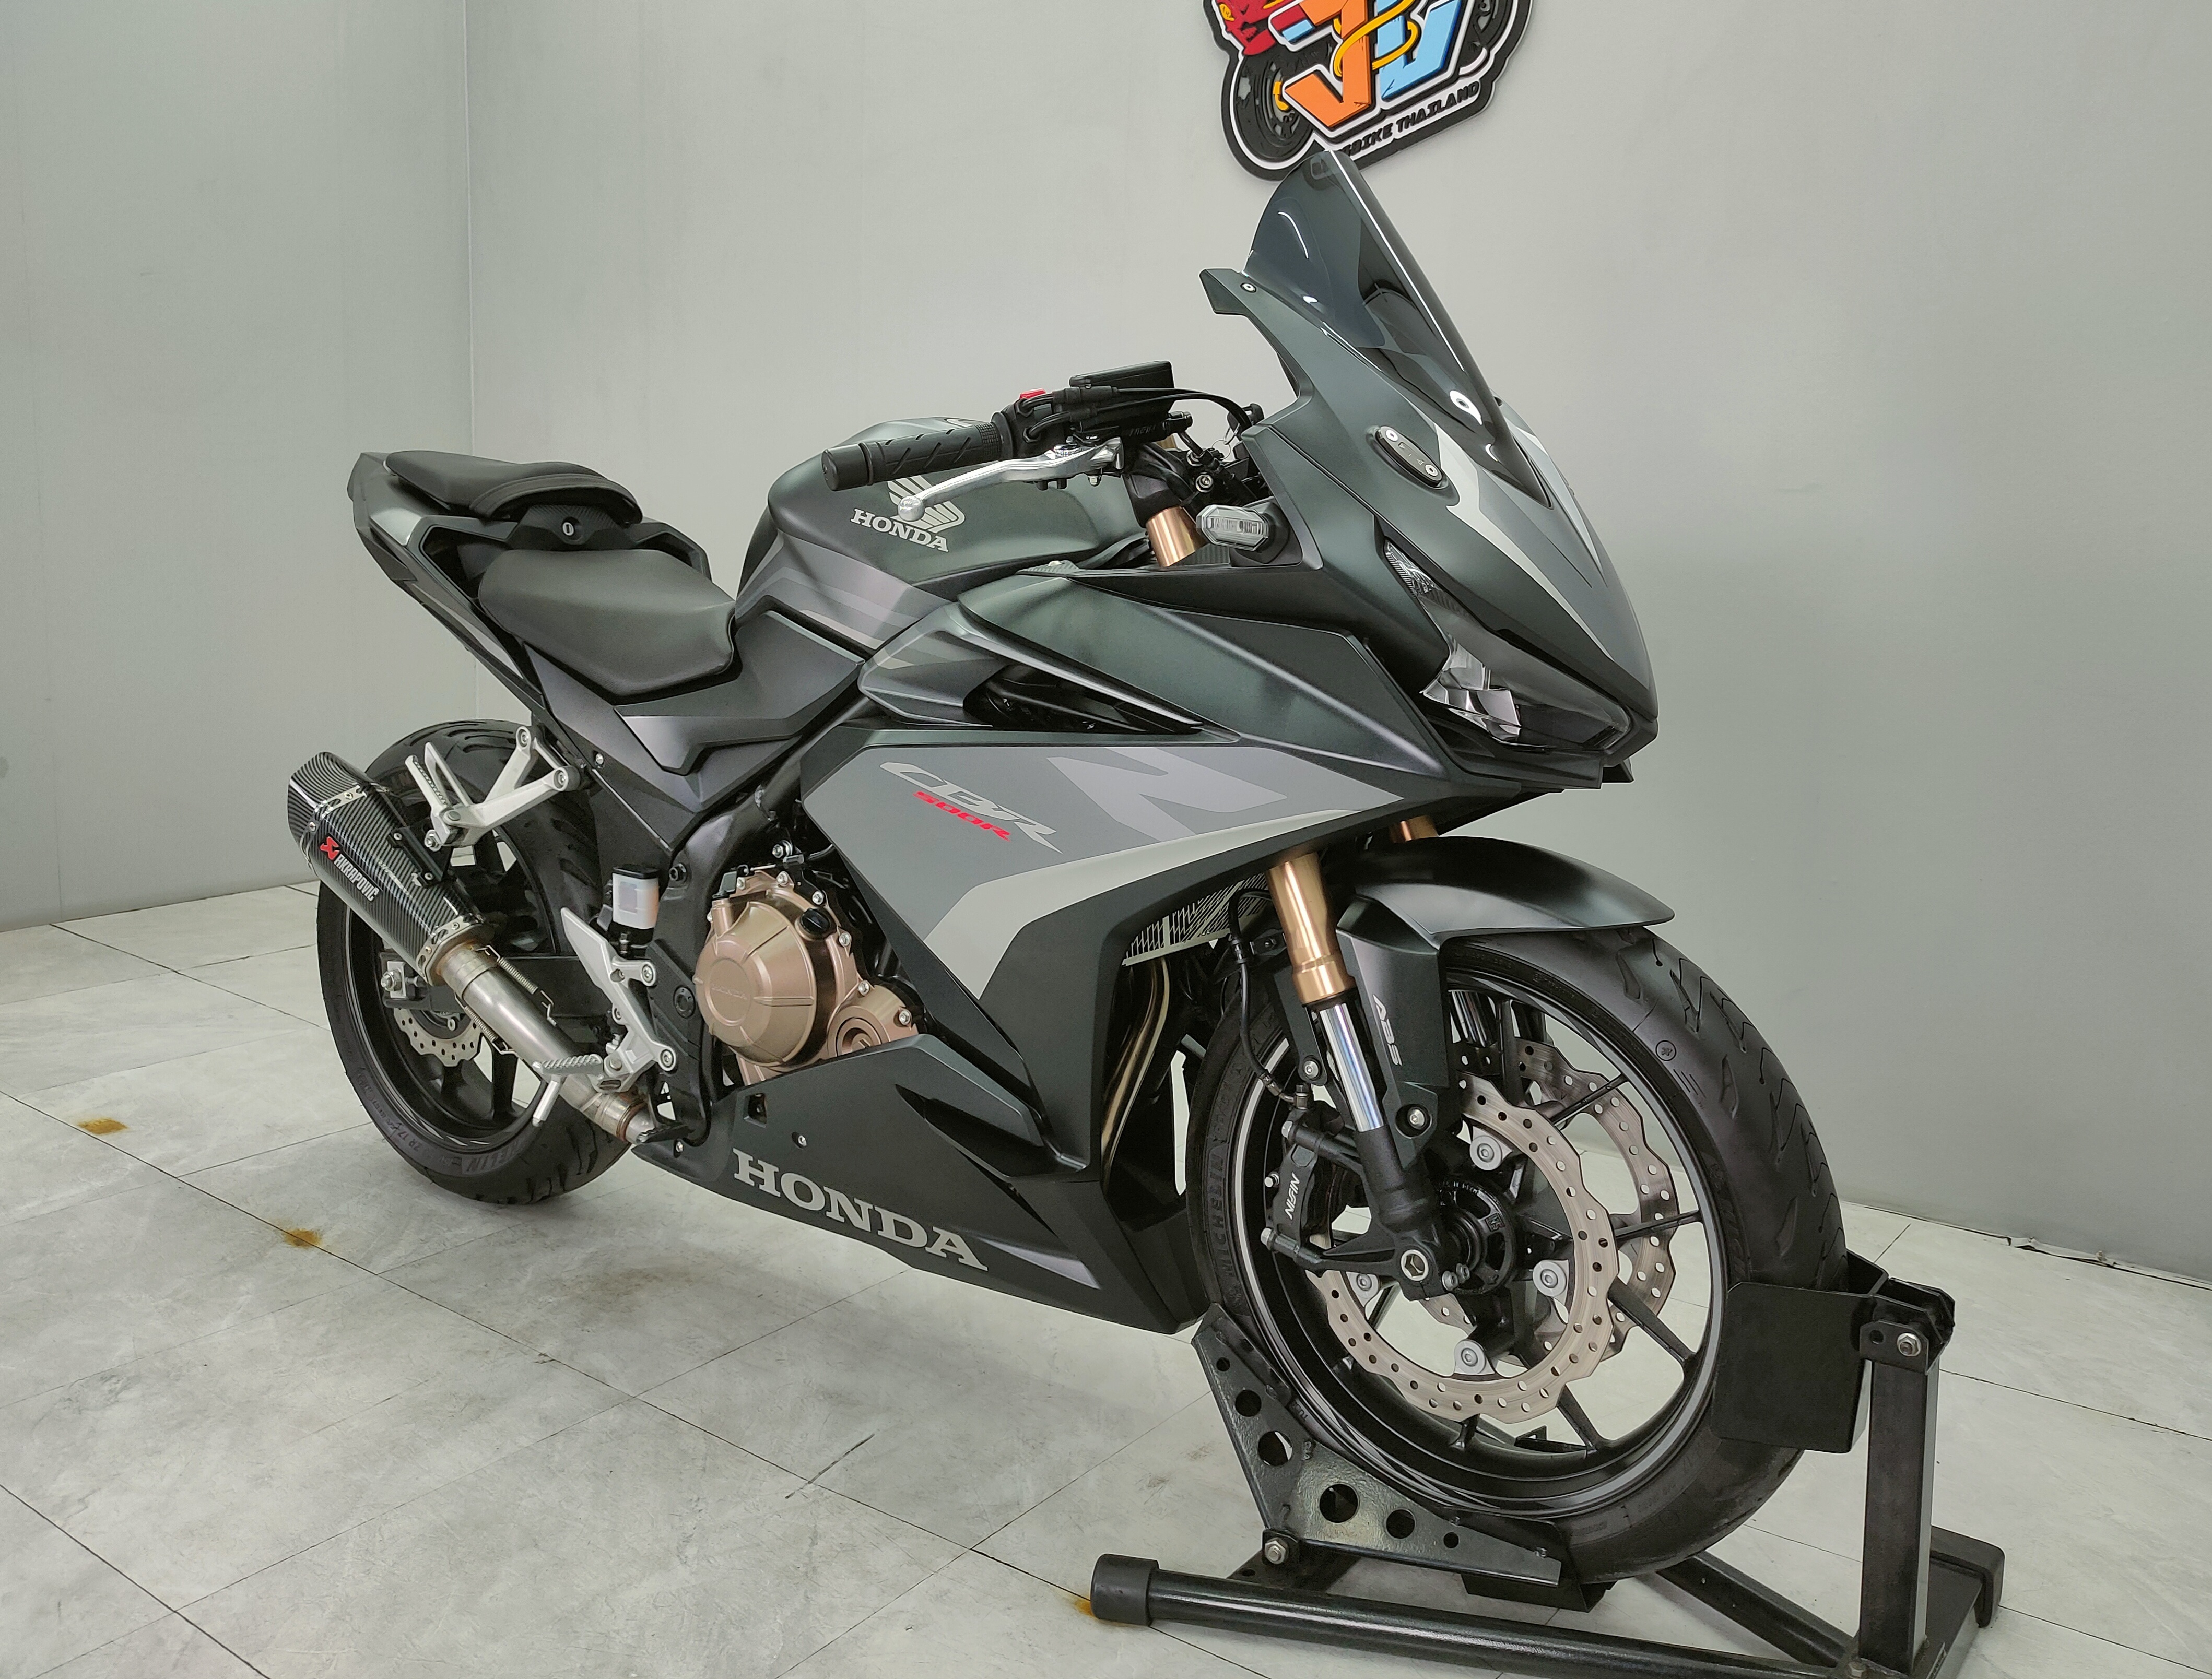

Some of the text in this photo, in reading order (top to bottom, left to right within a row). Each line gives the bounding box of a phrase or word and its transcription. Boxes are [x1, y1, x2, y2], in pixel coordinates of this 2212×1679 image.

[1396, 81, 1479, 133] THAILAND
[850, 508, 949, 552] HONDA
[880, 762, 1064, 854] CBR
[912, 790, 1011, 842] 500R
[733, 1148, 988, 1271] HONDA
[1285, 1172, 1300, 1220] NISSIN
